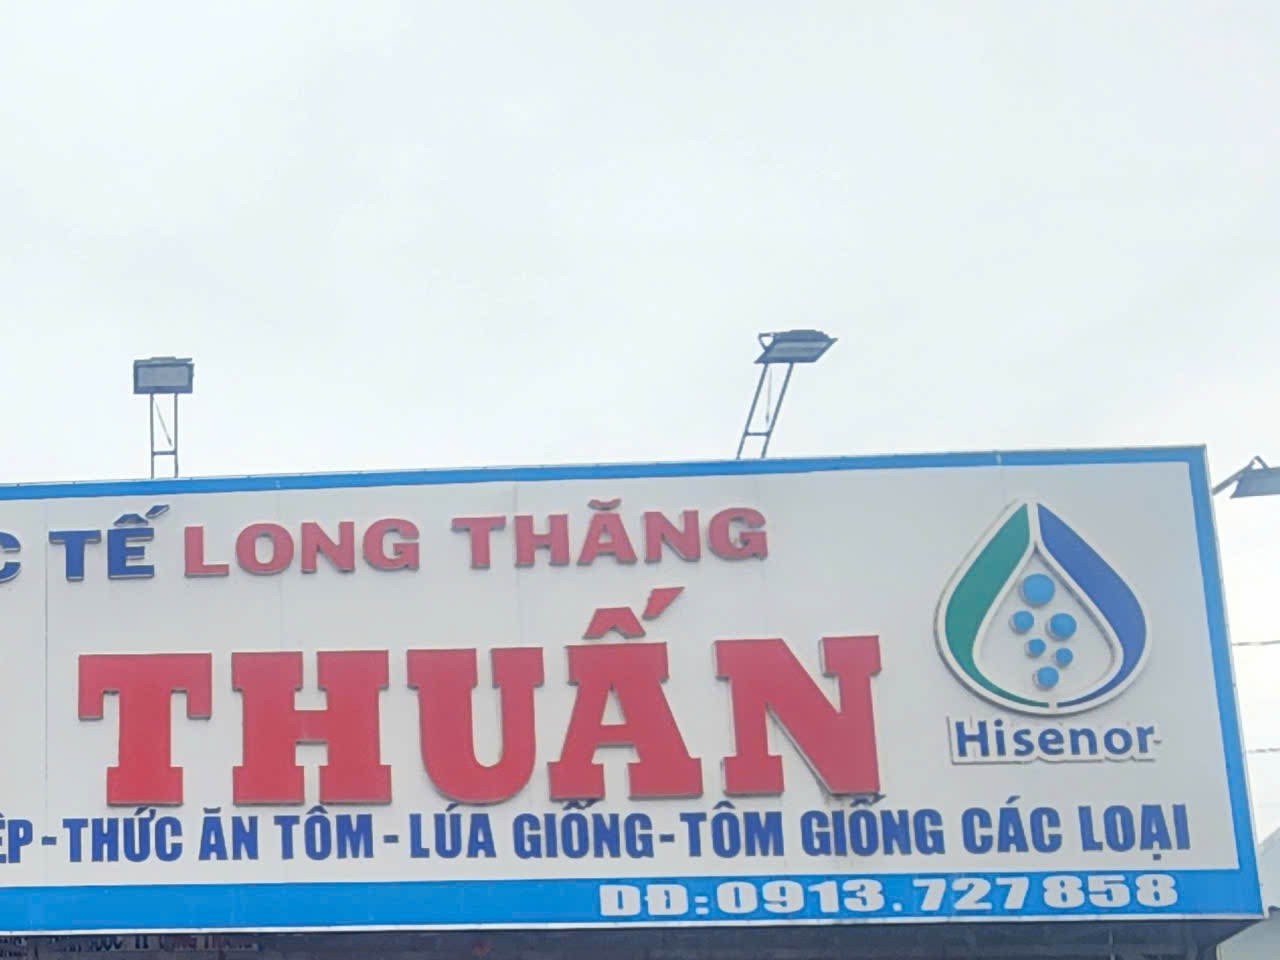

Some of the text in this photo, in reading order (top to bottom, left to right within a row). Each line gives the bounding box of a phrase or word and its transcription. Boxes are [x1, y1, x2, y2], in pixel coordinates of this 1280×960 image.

[48, 504, 169, 581] TẾ
[184, 522, 420, 577] LONG
[451, 498, 768, 570] THĂNG
[78, 586, 882, 808] THUẤN
[955, 718, 1155, 757] Hisenor
[62, 806, 183, 863] THỨC
[198, 807, 259, 861] ĂN
[274, 805, 374, 861] TÔM
[409, 802, 497, 859] LÚA
[801, 794, 946, 857] GIỐNG
[961, 795, 1063, 855] CÁC
[1078, 803, 1192, 862] LOẠI
